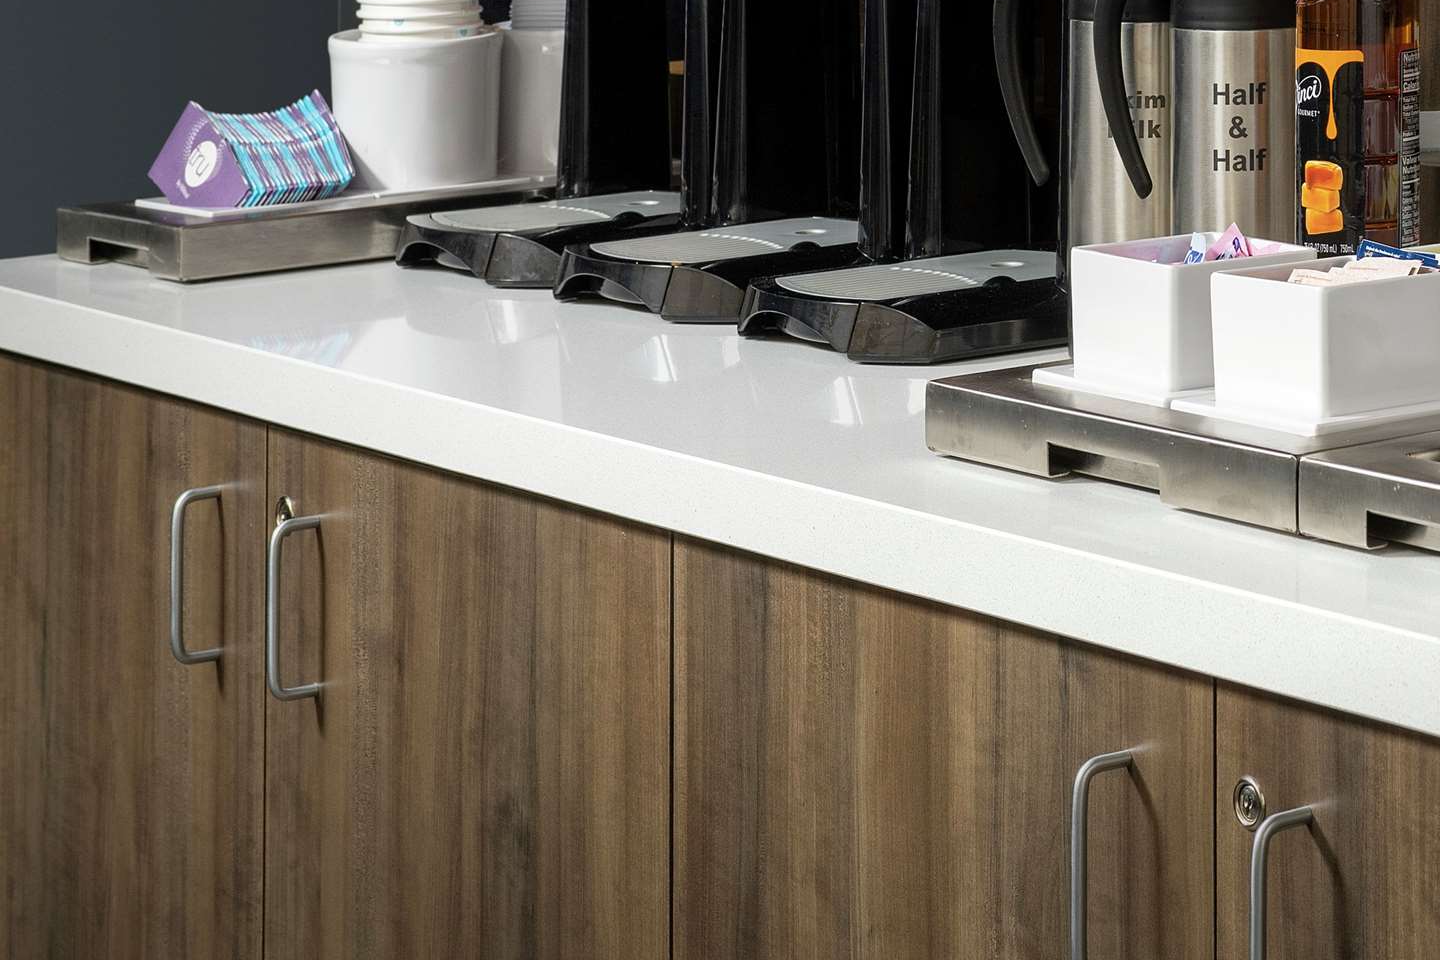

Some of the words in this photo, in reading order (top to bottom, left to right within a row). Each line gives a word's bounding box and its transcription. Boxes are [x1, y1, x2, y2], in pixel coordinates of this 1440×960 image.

[1213, 83, 1267, 105] Half
[1229, 116, 1248, 139] &
[1213, 149, 1267, 171] Half
